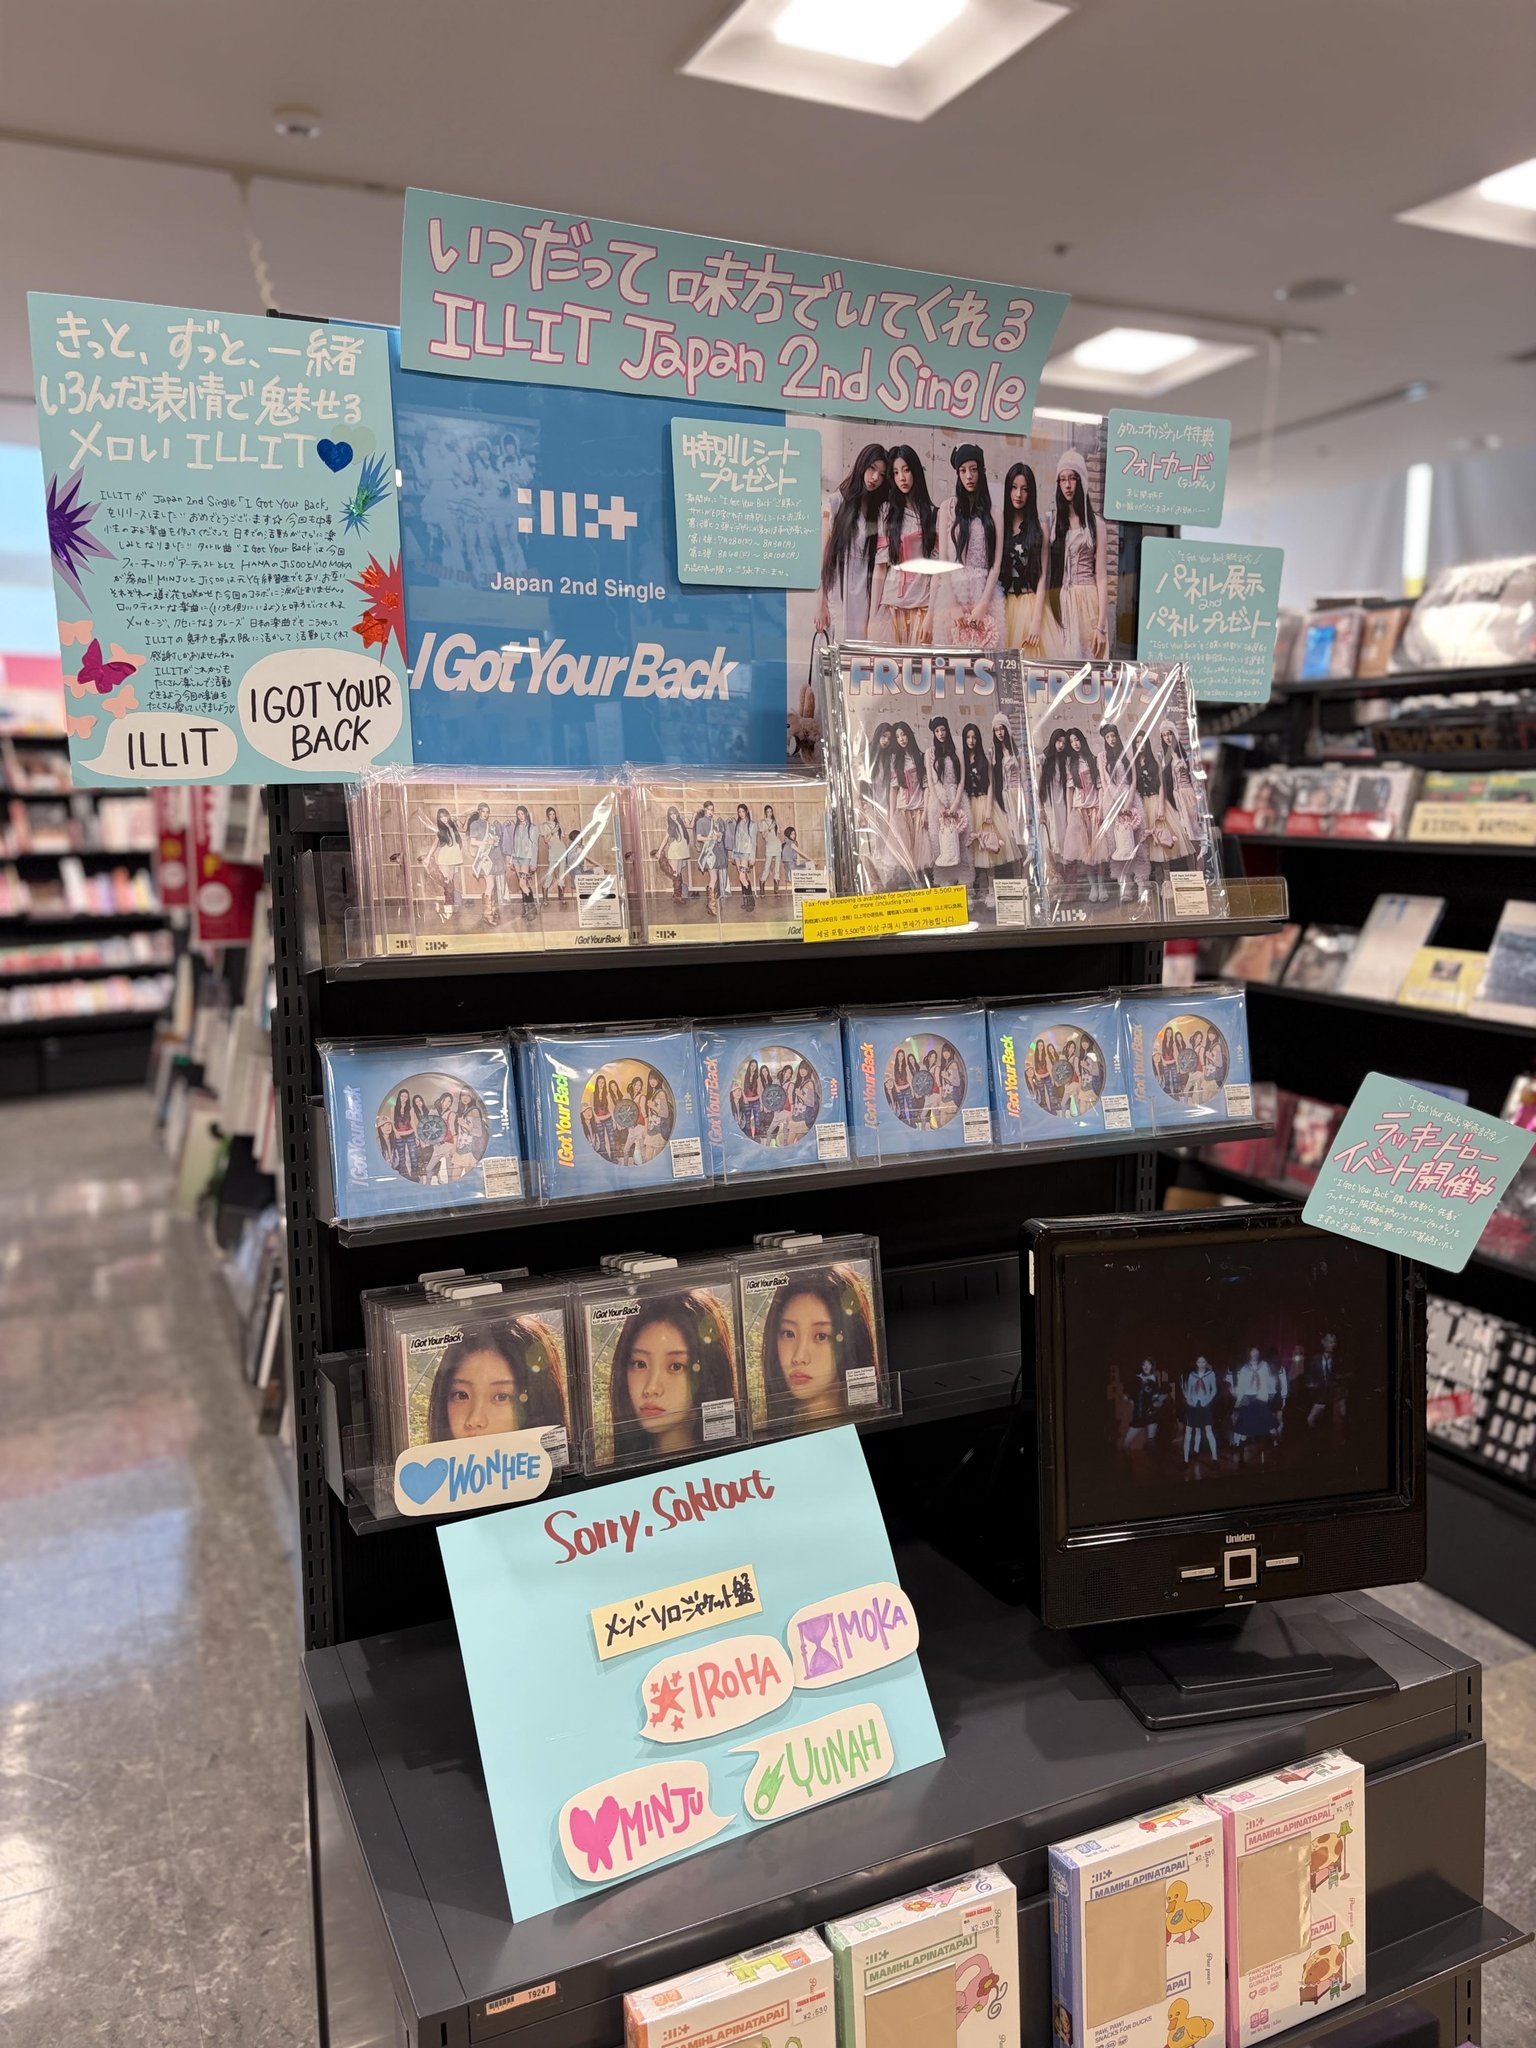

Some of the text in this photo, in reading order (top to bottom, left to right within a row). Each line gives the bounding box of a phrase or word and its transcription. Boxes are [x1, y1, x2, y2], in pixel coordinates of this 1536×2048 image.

[429, 290, 1026, 422] ILLIT Japan 2nd Single
[186, 431, 317, 470] ILLIT
[682, 430, 800, 469] 特別レシート
[1115, 446, 1214, 483] フォトカード
[153, 494, 182, 505] Japan
[187, 496, 204, 506] 2nd
[255, 498, 275, 509] Got
[277, 499, 299, 509] Your
[700, 464, 798, 496] プレゼント
[491, 572, 666, 603] Japan 2nd Single
[1155, 563, 1266, 605] パネル展示
[526, 636, 630, 697] Your
[623, 642, 739, 701] Back
[263, 681, 322, 723] GOT
[327, 675, 392, 712] YOUR
[128, 728, 219, 771] ILLIT
[291, 715, 372, 761] BACK
[450, 1449, 541, 1502] WONHEE
[838, 1597, 908, 1658] MOKA
[689, 1653, 782, 1719] IROHA
[785, 1719, 882, 1798] YUNAH
[619, 1782, 704, 1862] MINJU
[1248, 1808, 1331, 1846] MAMIHLAPINATAPAI
[1094, 1860, 1185, 1899] MAMIHLAPINATAPAI
[869, 1936, 973, 1983] MAMIHLAPINATAPAI
[528, 1985, 551, 2000] T9247
